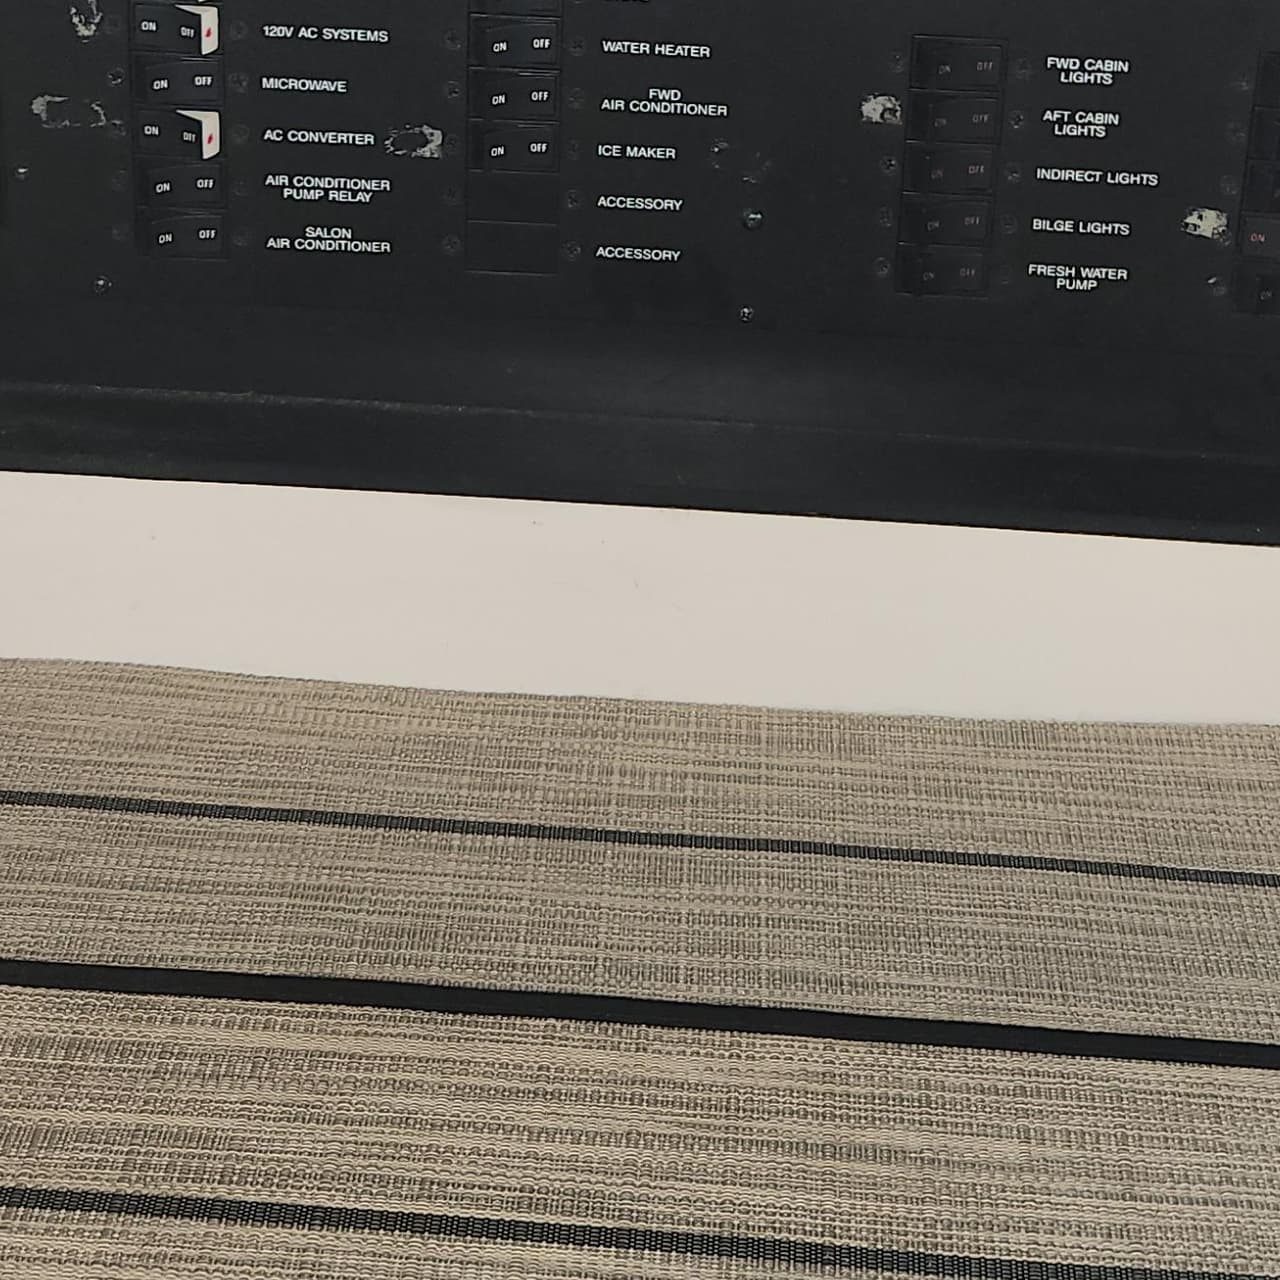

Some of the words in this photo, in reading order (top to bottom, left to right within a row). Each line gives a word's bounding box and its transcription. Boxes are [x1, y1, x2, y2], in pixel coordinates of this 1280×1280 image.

[263, 25, 294, 38] 120V
[297, 26, 318, 39] AC
[322, 27, 389, 43] SYSTEMS
[602, 40, 650, 54] WATER
[654, 43, 710, 58] HEATER
[1047, 56, 1081, 70] FWD
[1084, 58, 1129, 73] CABIN
[262, 77, 347, 93] MICROWAVE
[1060, 71, 1113, 85] LIGHTS
[649, 88, 681, 101] FWD
[601, 99, 625, 111] AIR
[629, 100, 728, 116] CONDITIONER
[1042, 110, 1072, 122] AFT
[1074, 111, 1119, 126] CABIN
[263, 129, 283, 141] AC
[287, 130, 375, 145] CONVERTER
[1054, 123, 1106, 138] LIGHTS
[598, 144, 622, 157] ICE
[626, 145, 676, 159] MAKER
[265, 174, 289, 186] AIR
[292, 175, 391, 193] CONDITIONER
[1036, 167, 1103, 182] INDIRECT
[1106, 172, 1158, 186] LIGHTS
[283, 187, 325, 200] PUMP
[328, 190, 373, 203] RELAY
[597, 196, 683, 211] ACCESSORY
[305, 226, 352, 239] SALON
[1032, 218, 1075, 233] BILGE
[1079, 221, 1130, 236] LIGHTS
[266, 237, 291, 249] AIR
[294, 238, 391, 253] CONDITIONER
[595, 246, 681, 261] ACCESSORY
[1028, 263, 1076, 278] FRESH
[1080, 266, 1128, 280] WATER
[1056, 277, 1098, 291] PUMP
